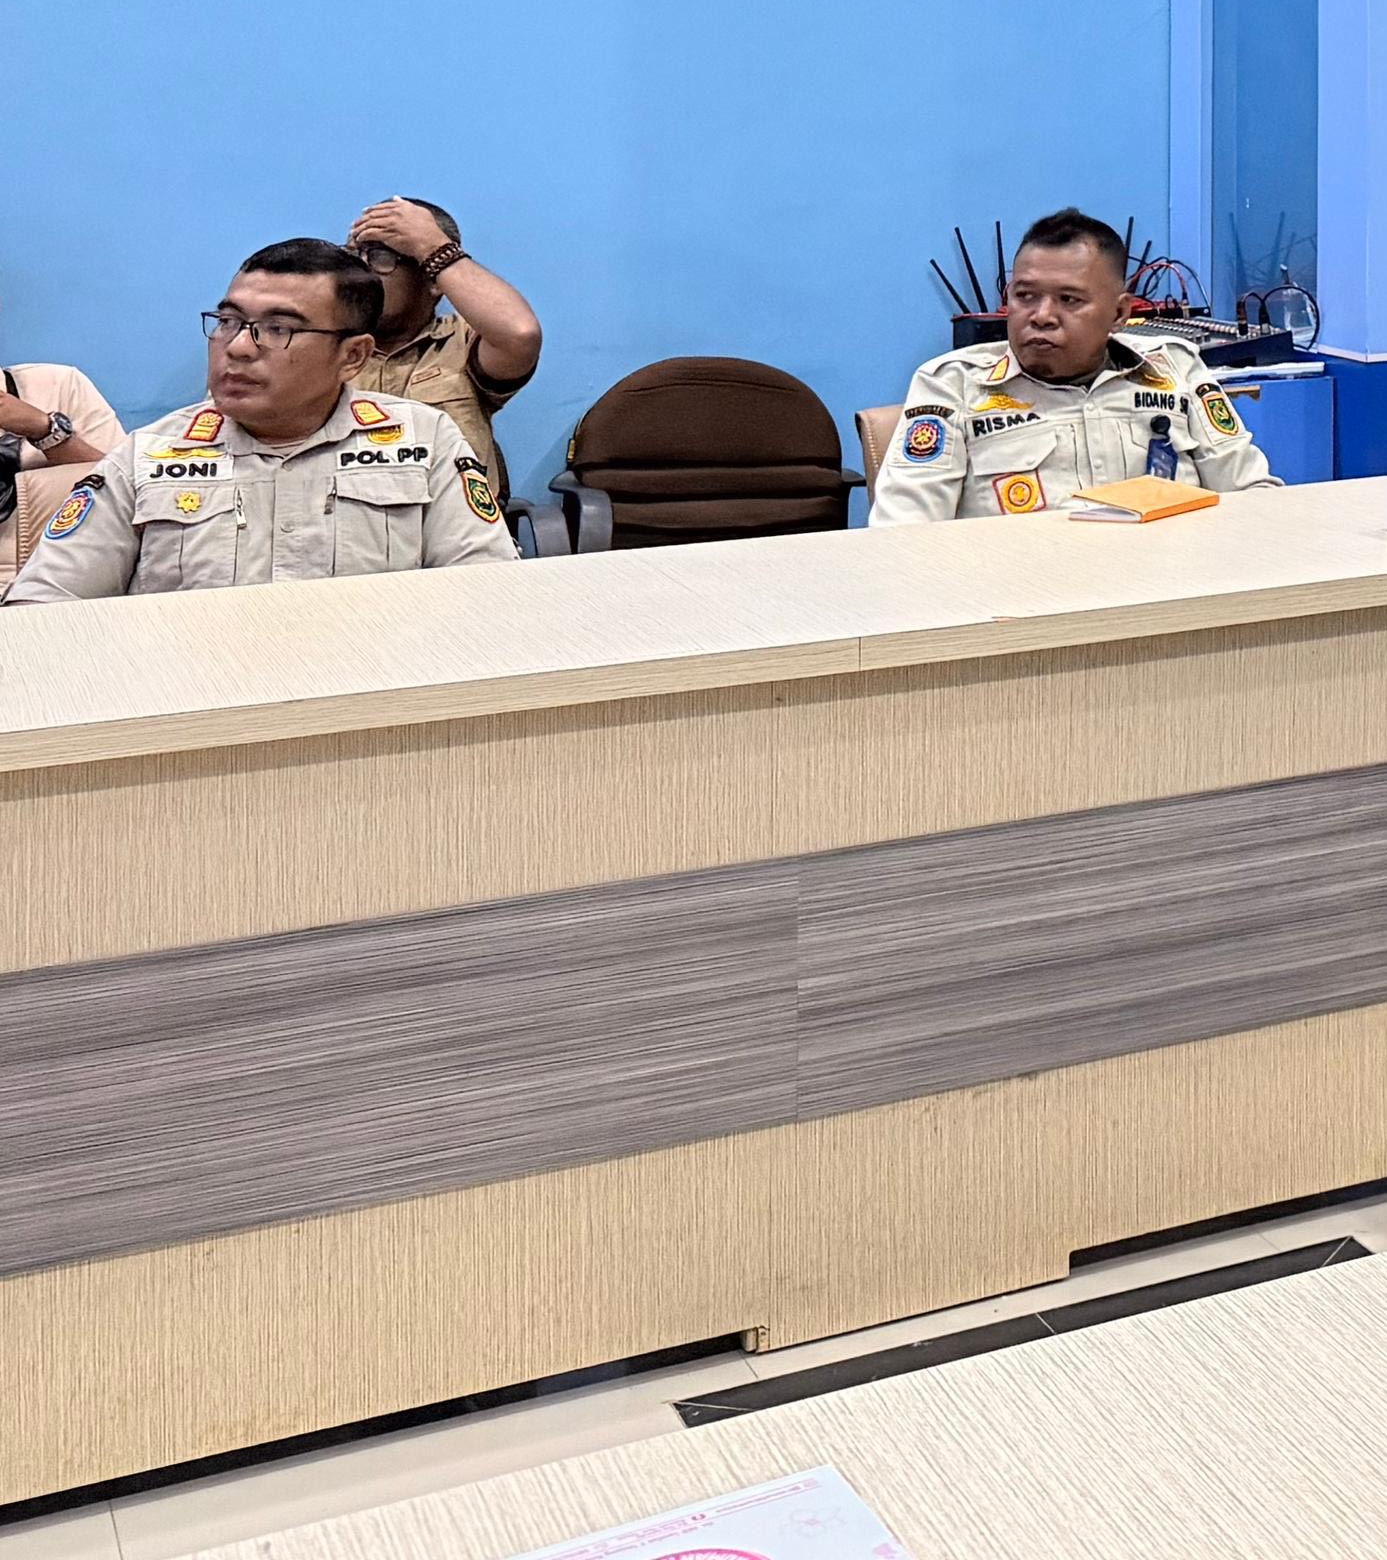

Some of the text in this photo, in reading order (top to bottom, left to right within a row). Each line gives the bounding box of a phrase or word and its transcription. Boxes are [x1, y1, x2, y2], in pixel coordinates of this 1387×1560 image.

[1134, 391, 1175, 410] BIDANG
[973, 412, 1042, 437] RISMA
[340, 446, 429, 466] POL PP
[149, 462, 218, 480] JONI
